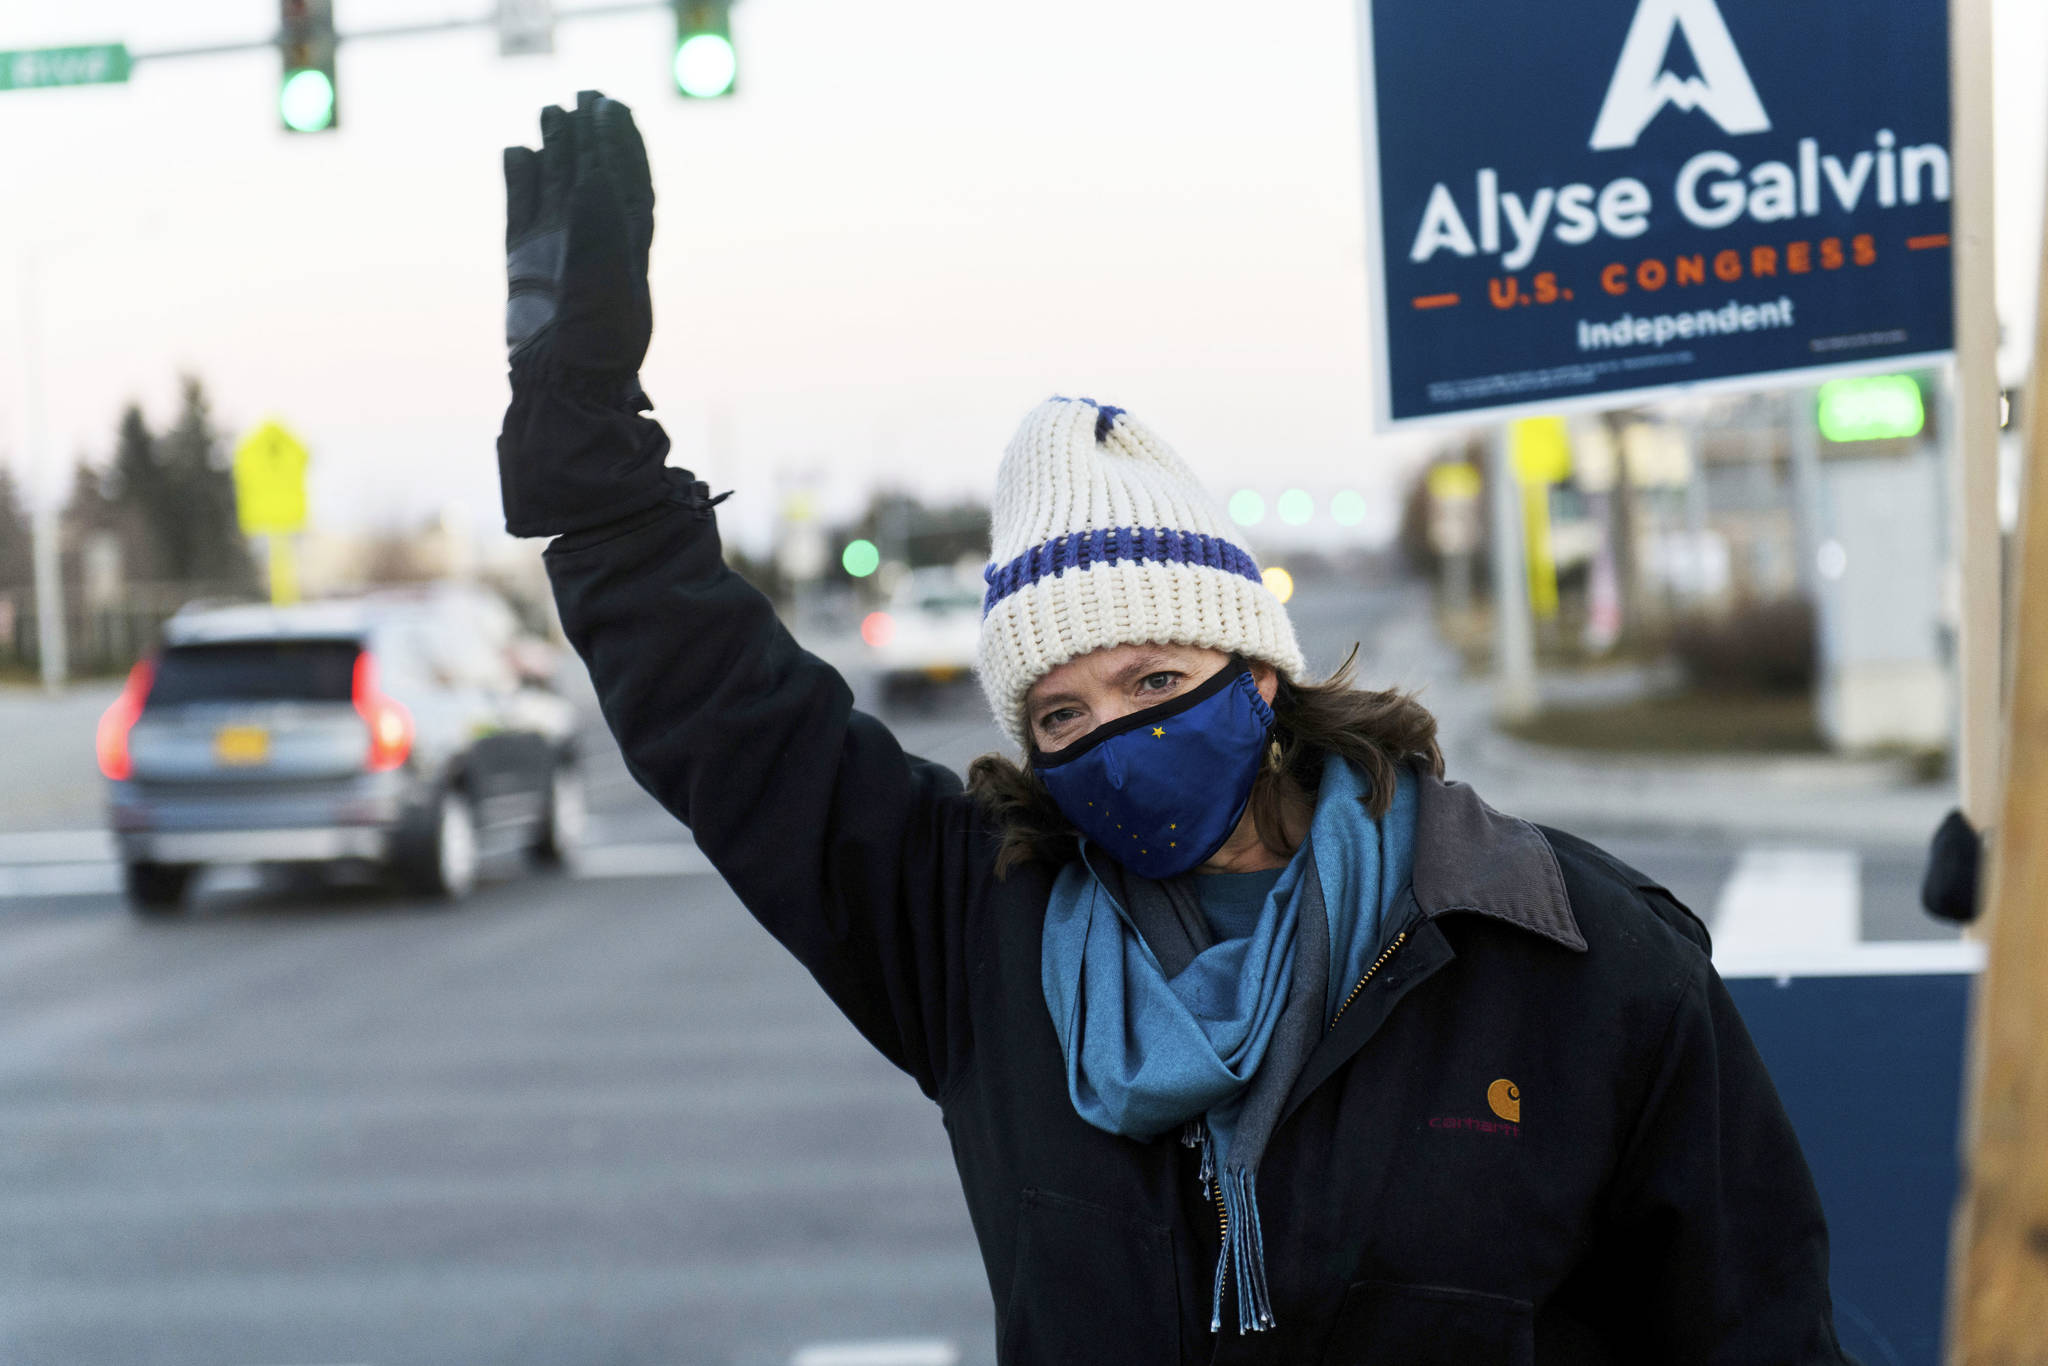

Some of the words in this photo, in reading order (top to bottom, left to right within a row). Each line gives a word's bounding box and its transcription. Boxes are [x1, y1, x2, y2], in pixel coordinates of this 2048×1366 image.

[1411, 169, 1651, 270] Alyse
[1676, 130, 1951, 227] Galvin
[1489, 271, 1574, 309] U.S.
[1601, 234, 1877, 295] CONGRESS
[1579, 298, 1793, 350] Independent
[1428, 1117, 1519, 1138] carhartt
